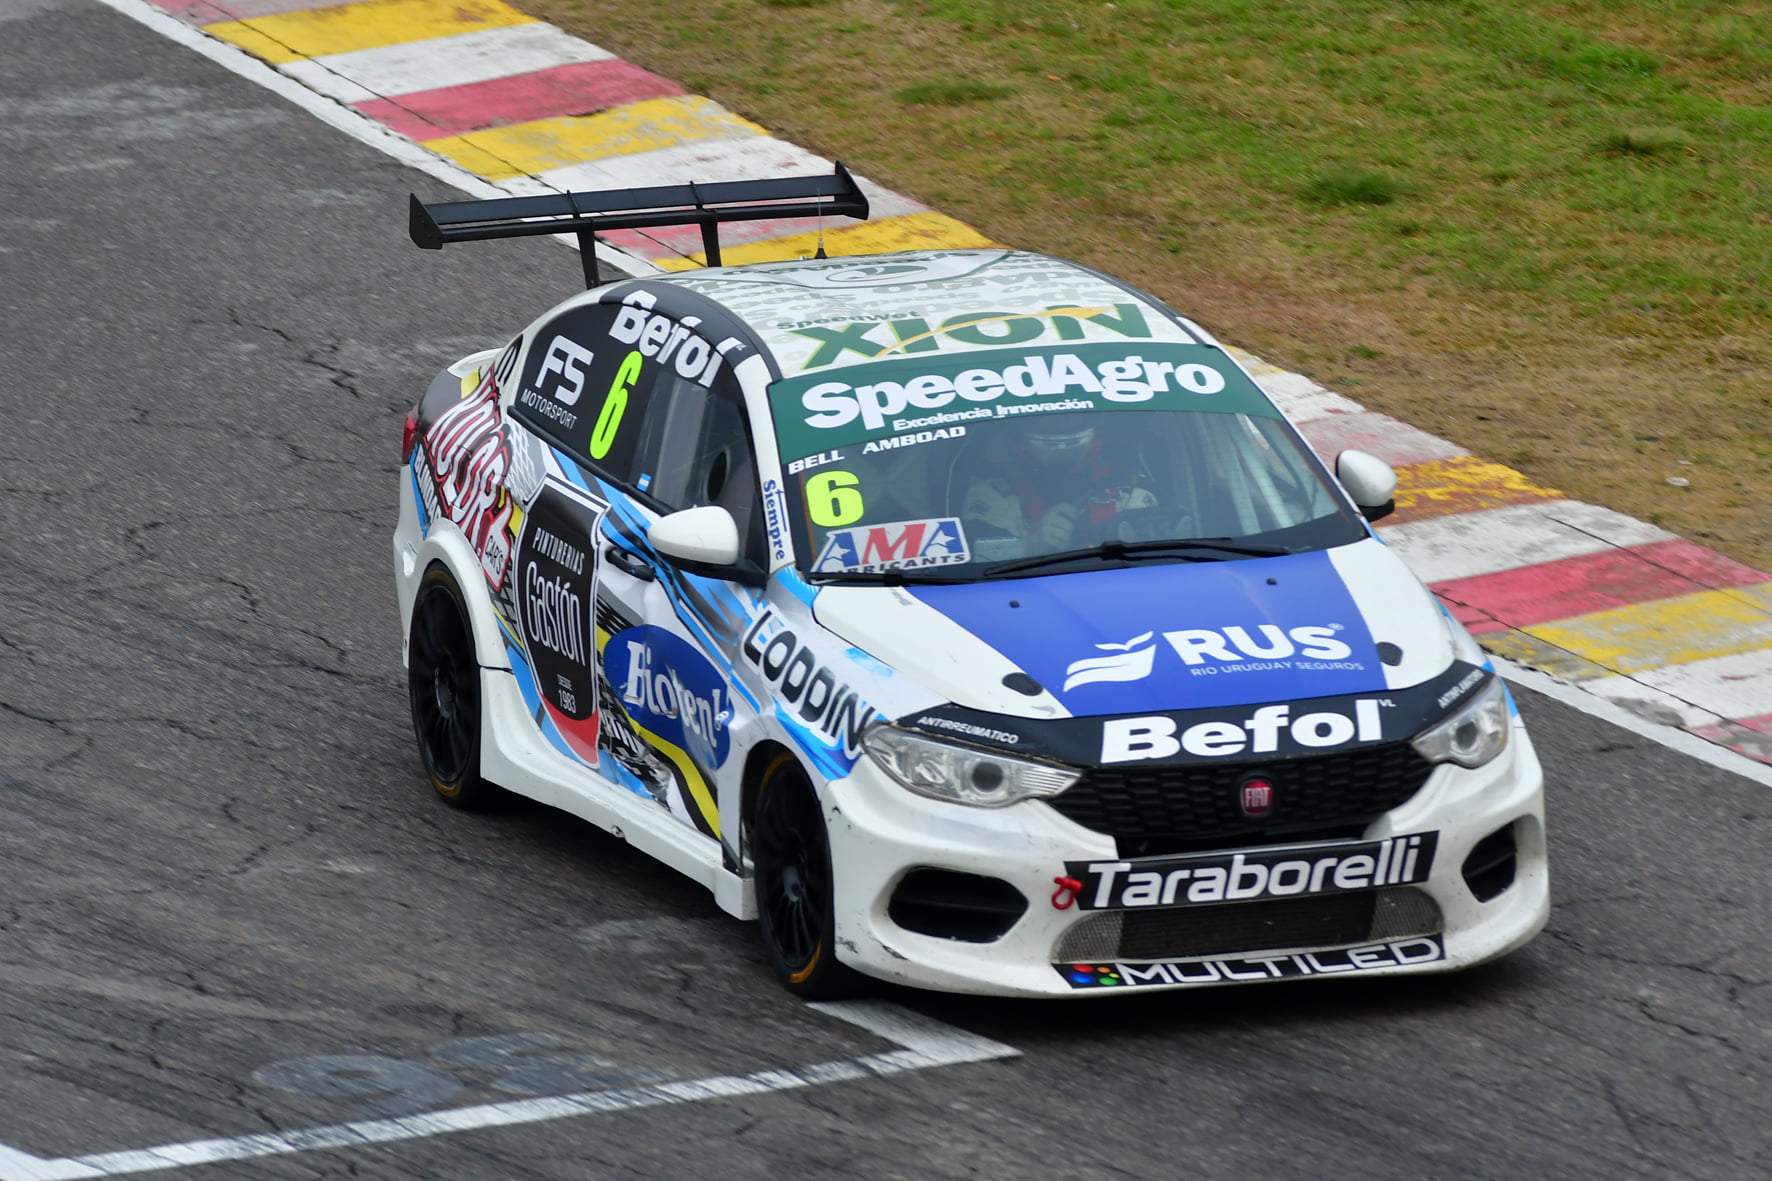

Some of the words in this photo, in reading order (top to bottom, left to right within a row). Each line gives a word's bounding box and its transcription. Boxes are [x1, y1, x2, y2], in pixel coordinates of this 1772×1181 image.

[608, 290, 741, 388] Befol
[788, 303, 1153, 370] XION
[520, 388, 578, 430] MOTORSPORT
[590, 350, 643, 460] 6
[802, 353, 1225, 431] SpeedAgro
[892, 408, 992, 431] Excelencia
[788, 450, 845, 475] BELL
[862, 426, 967, 455] AMBOAD
[763, 478, 785, 561] Siempre
[805, 470, 865, 528] 6
[532, 527, 585, 576] PINTURERIAS
[817, 521, 966, 573] AMA
[838, 553, 967, 574] BRICANTS
[525, 560, 586, 668] Gastón
[1162, 624, 1352, 666] RUS
[1191, 667, 1218, 677] RIO
[1220, 661, 1292, 674] URUGUAY
[1296, 661, 1365, 672] SEGUROS
[558, 689, 577, 714] 1983
[916, 716, 1020, 744] ANTIRREUMATICO
[1101, 698, 1383, 764] Befol
[1245, 786, 1271, 808] FIAT
[1088, 836, 1422, 908] Taraborelli
[1115, 936, 1442, 986] MULTILED
